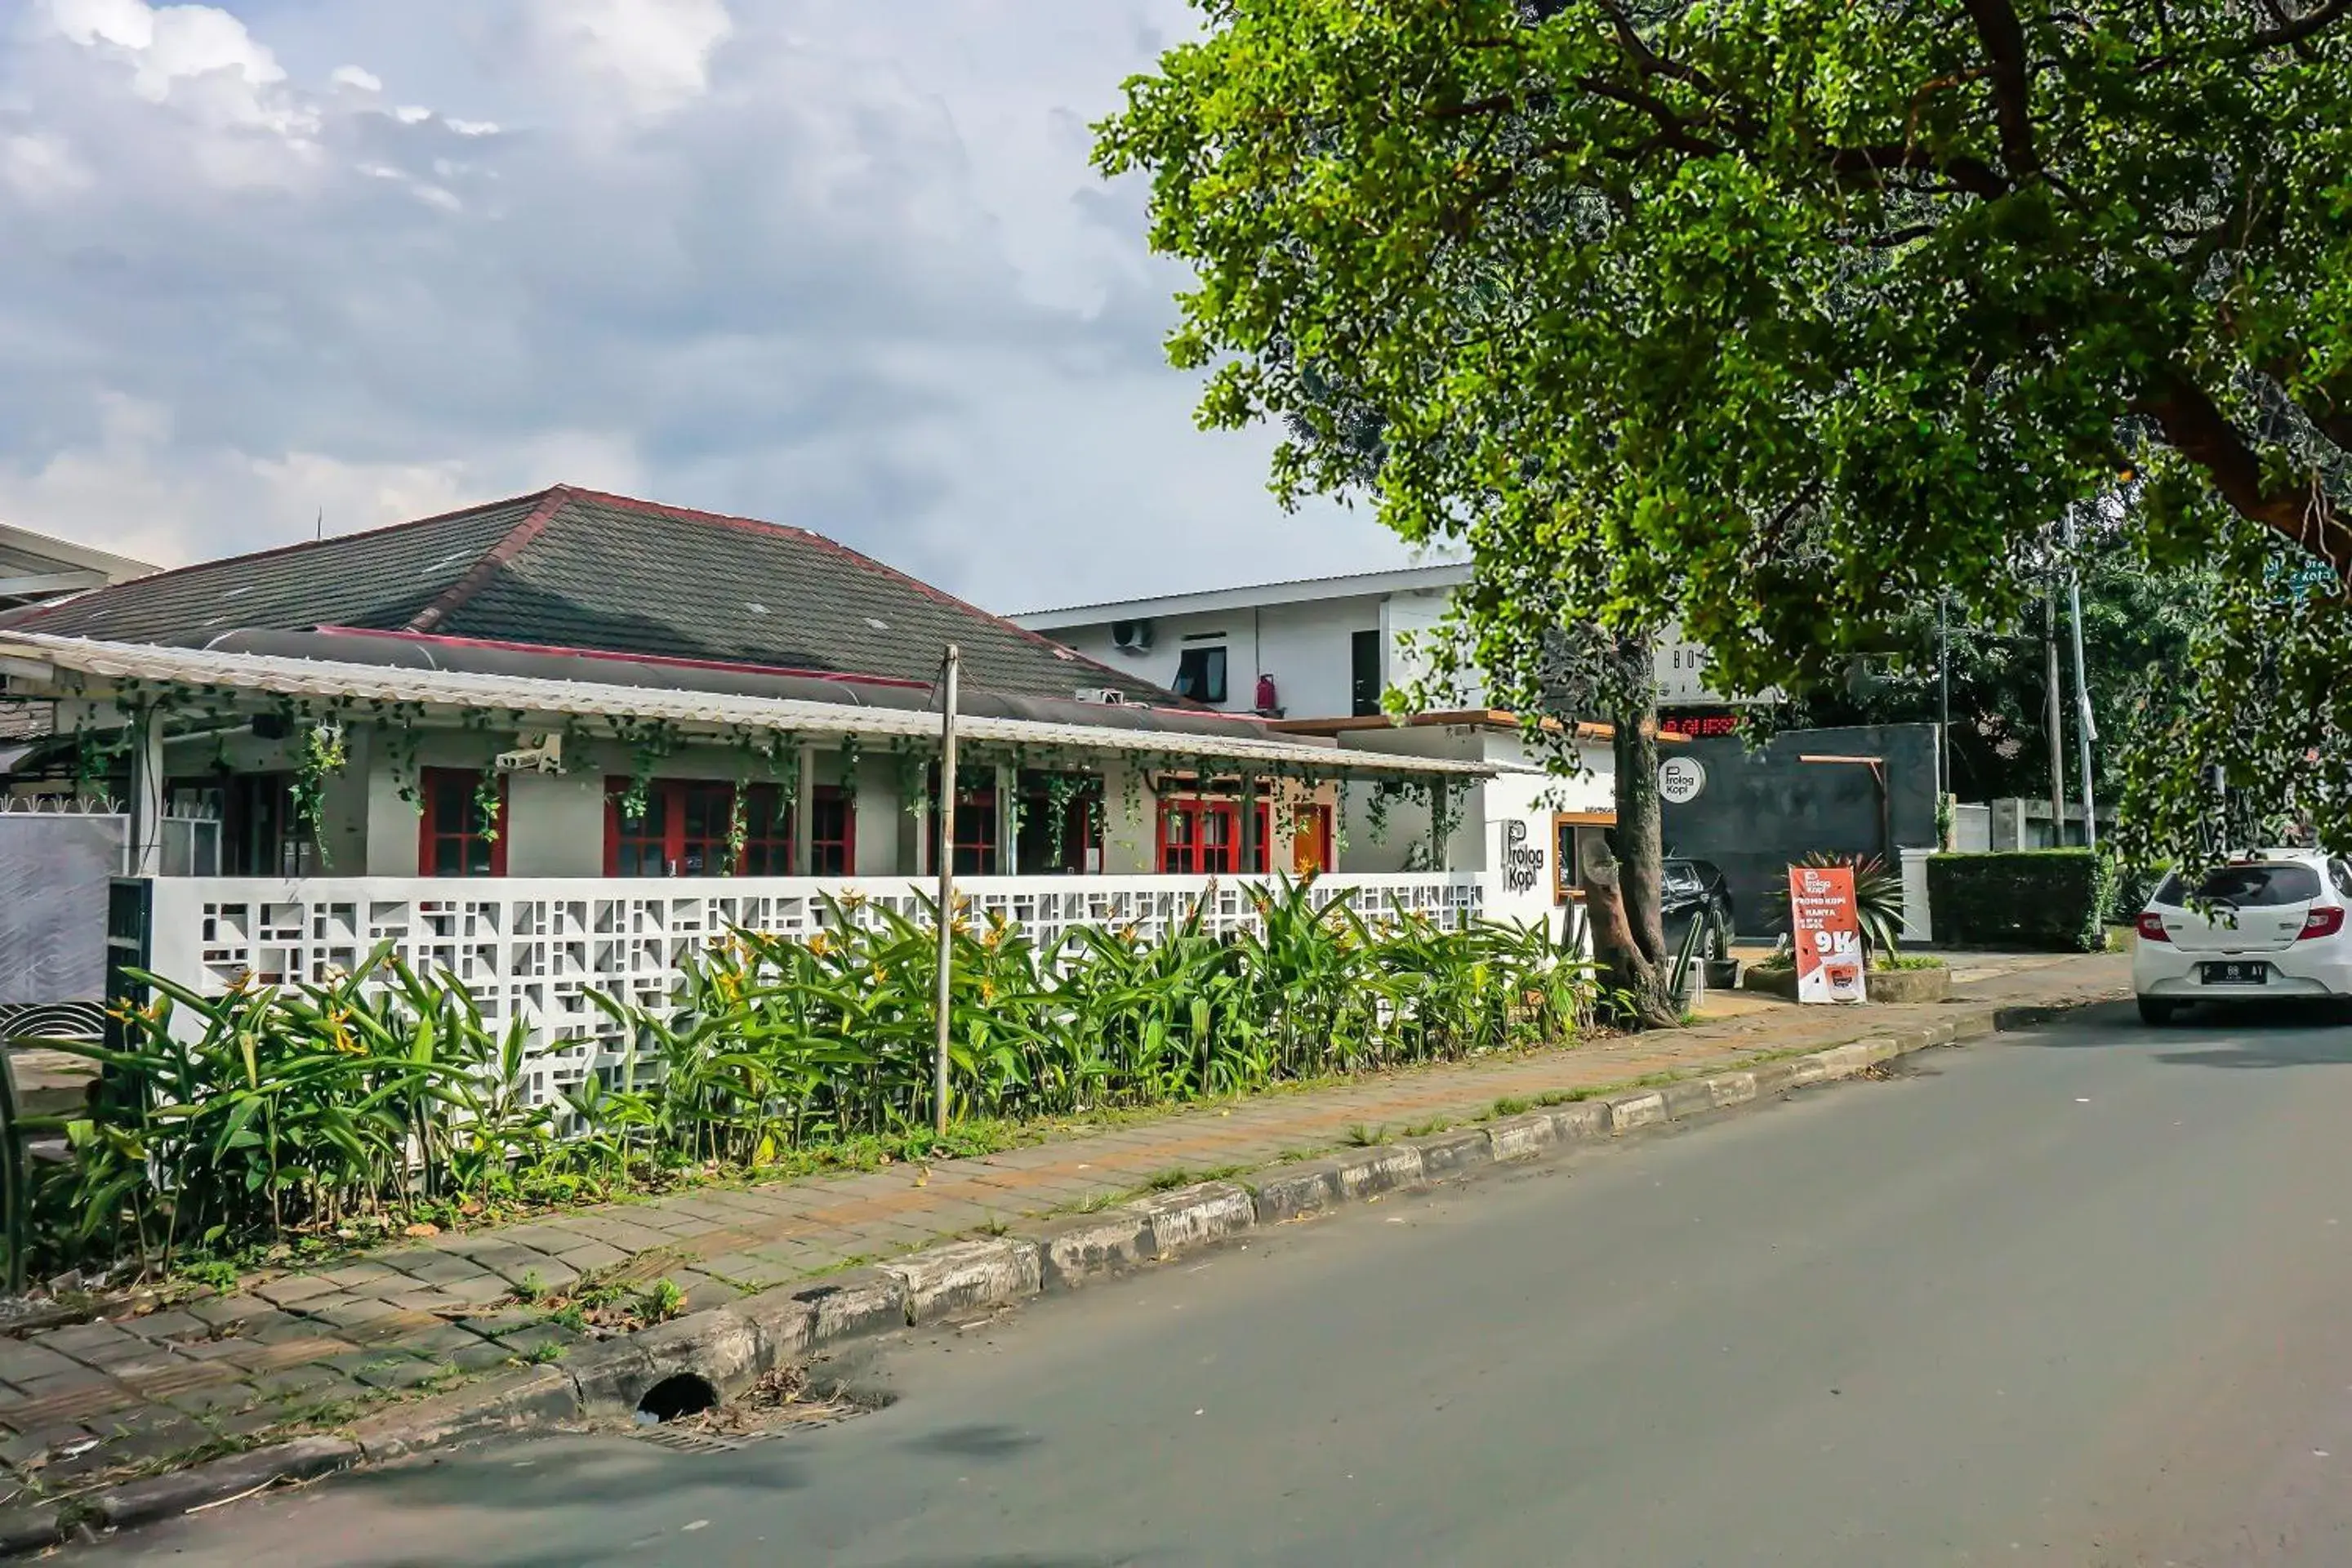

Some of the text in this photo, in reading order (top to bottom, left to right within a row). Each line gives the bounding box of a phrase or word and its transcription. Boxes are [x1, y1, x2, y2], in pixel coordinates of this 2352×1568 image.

[1666, 766, 1694, 786] Prolog
[1666, 786, 1688, 795] Kopi
[1508, 819, 1544, 868] Prolog
[1509, 865, 1537, 892] Kopi
[1815, 930, 1854, 953] 9K
